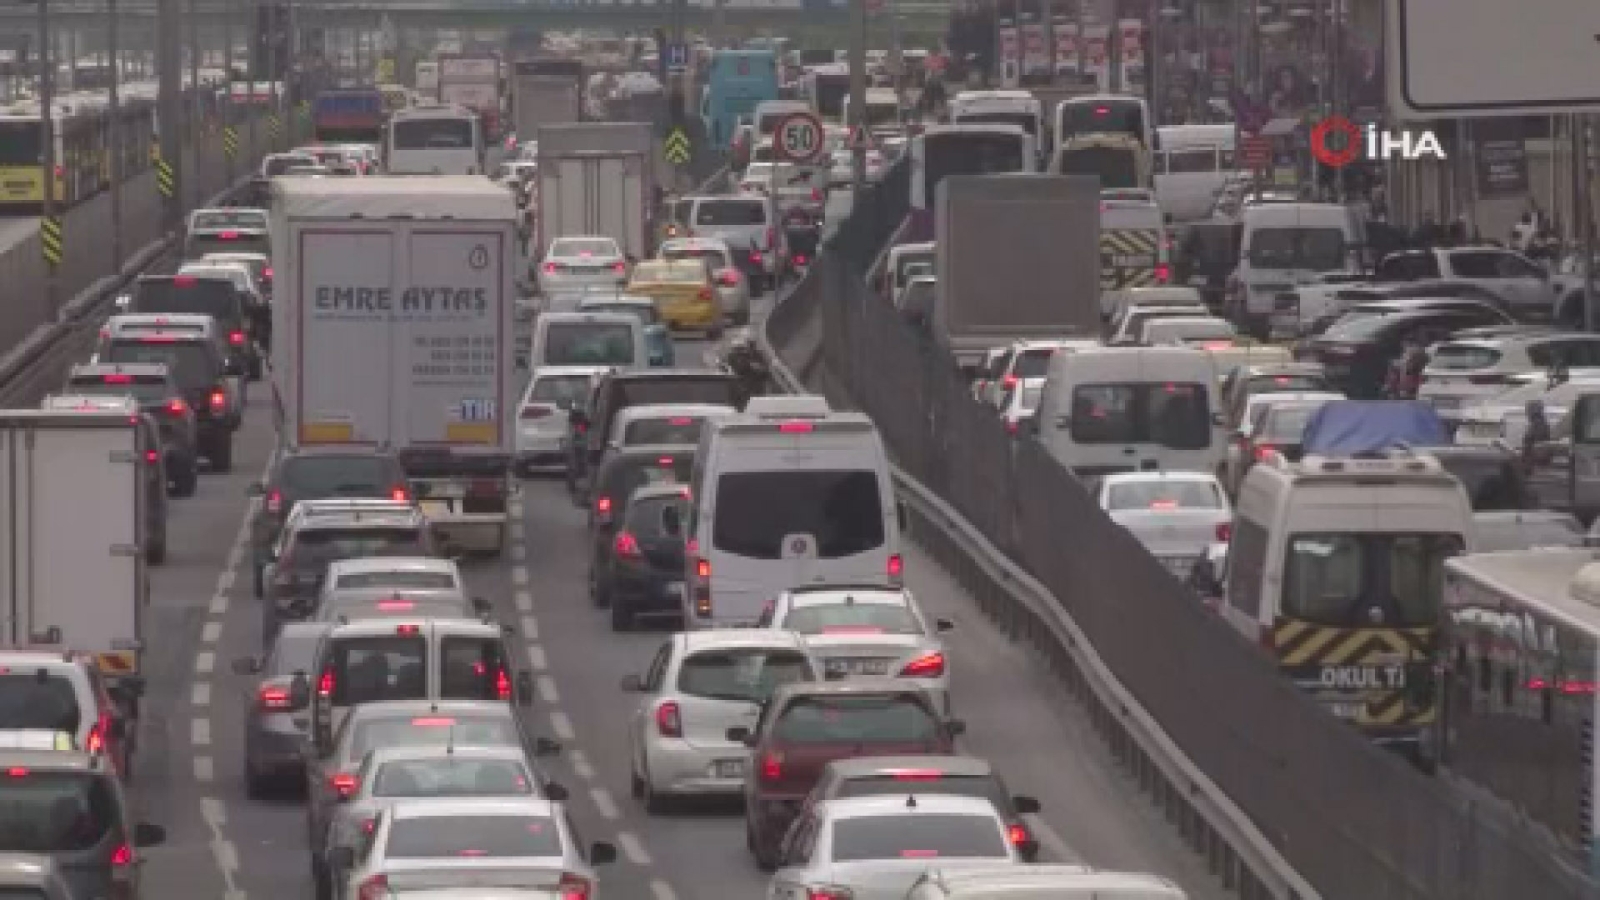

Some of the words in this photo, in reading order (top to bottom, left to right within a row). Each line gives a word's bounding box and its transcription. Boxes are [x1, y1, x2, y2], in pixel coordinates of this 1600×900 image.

[787, 125, 813, 150] 50
[315, 286, 392, 311] EMRE
[1321, 666, 1382, 688] OKUL
